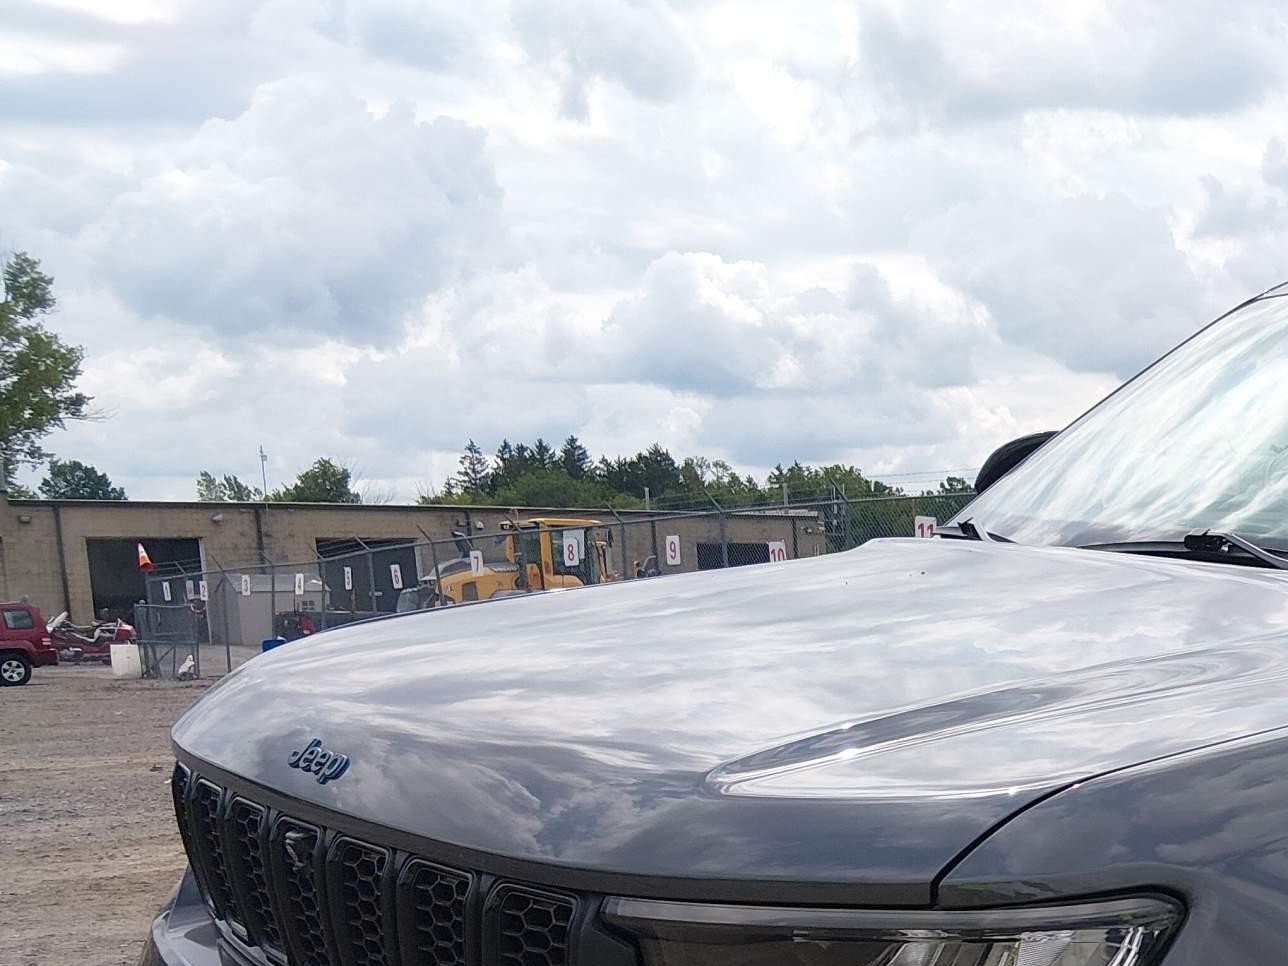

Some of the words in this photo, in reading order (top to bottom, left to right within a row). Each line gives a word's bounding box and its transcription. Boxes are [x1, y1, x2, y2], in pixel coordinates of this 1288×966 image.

[567, 543, 575, 561] 8
[669, 541, 677, 560] 9
[770, 548, 785, 562] 10
[473, 556, 480, 573] 7
[393, 568, 400, 585] 6
[201, 584, 207, 598] 2
[243, 578, 249, 593] 3
[288, 738, 351, 785] Jeep
